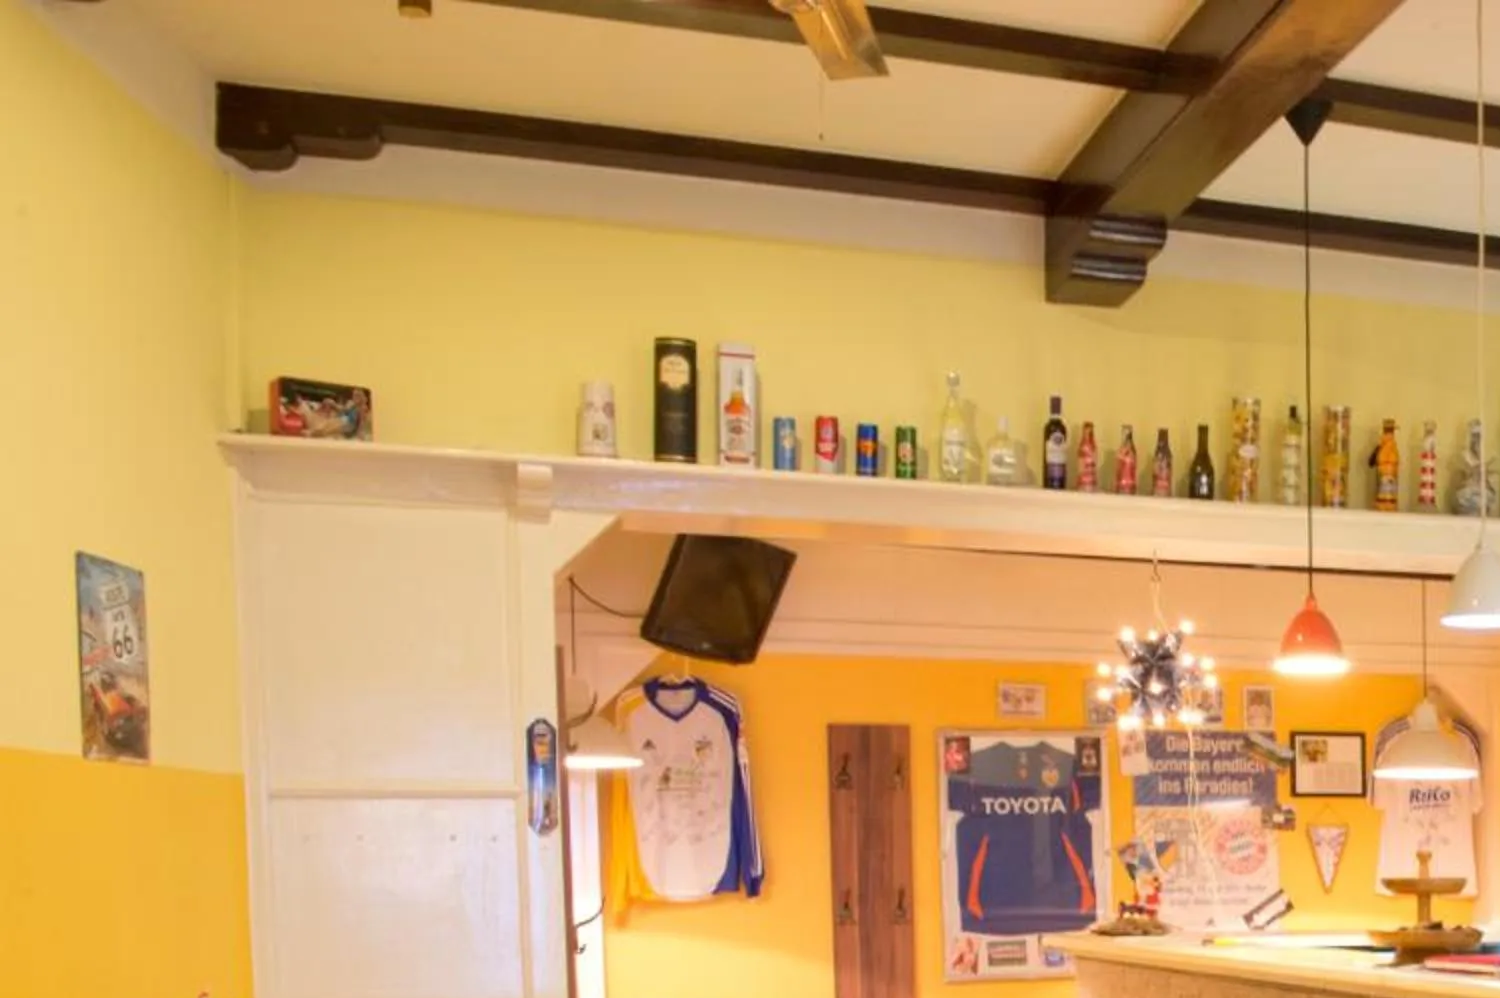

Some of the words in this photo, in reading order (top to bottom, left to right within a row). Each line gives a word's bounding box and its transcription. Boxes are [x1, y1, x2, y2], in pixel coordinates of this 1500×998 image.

[112, 623, 134, 659] 66
[1166, 734, 1188, 751] Die
[1213, 757, 1265, 773] endlich
[1158, 776, 1181, 794] ins
[981, 796, 1067, 815] TOYOTA
